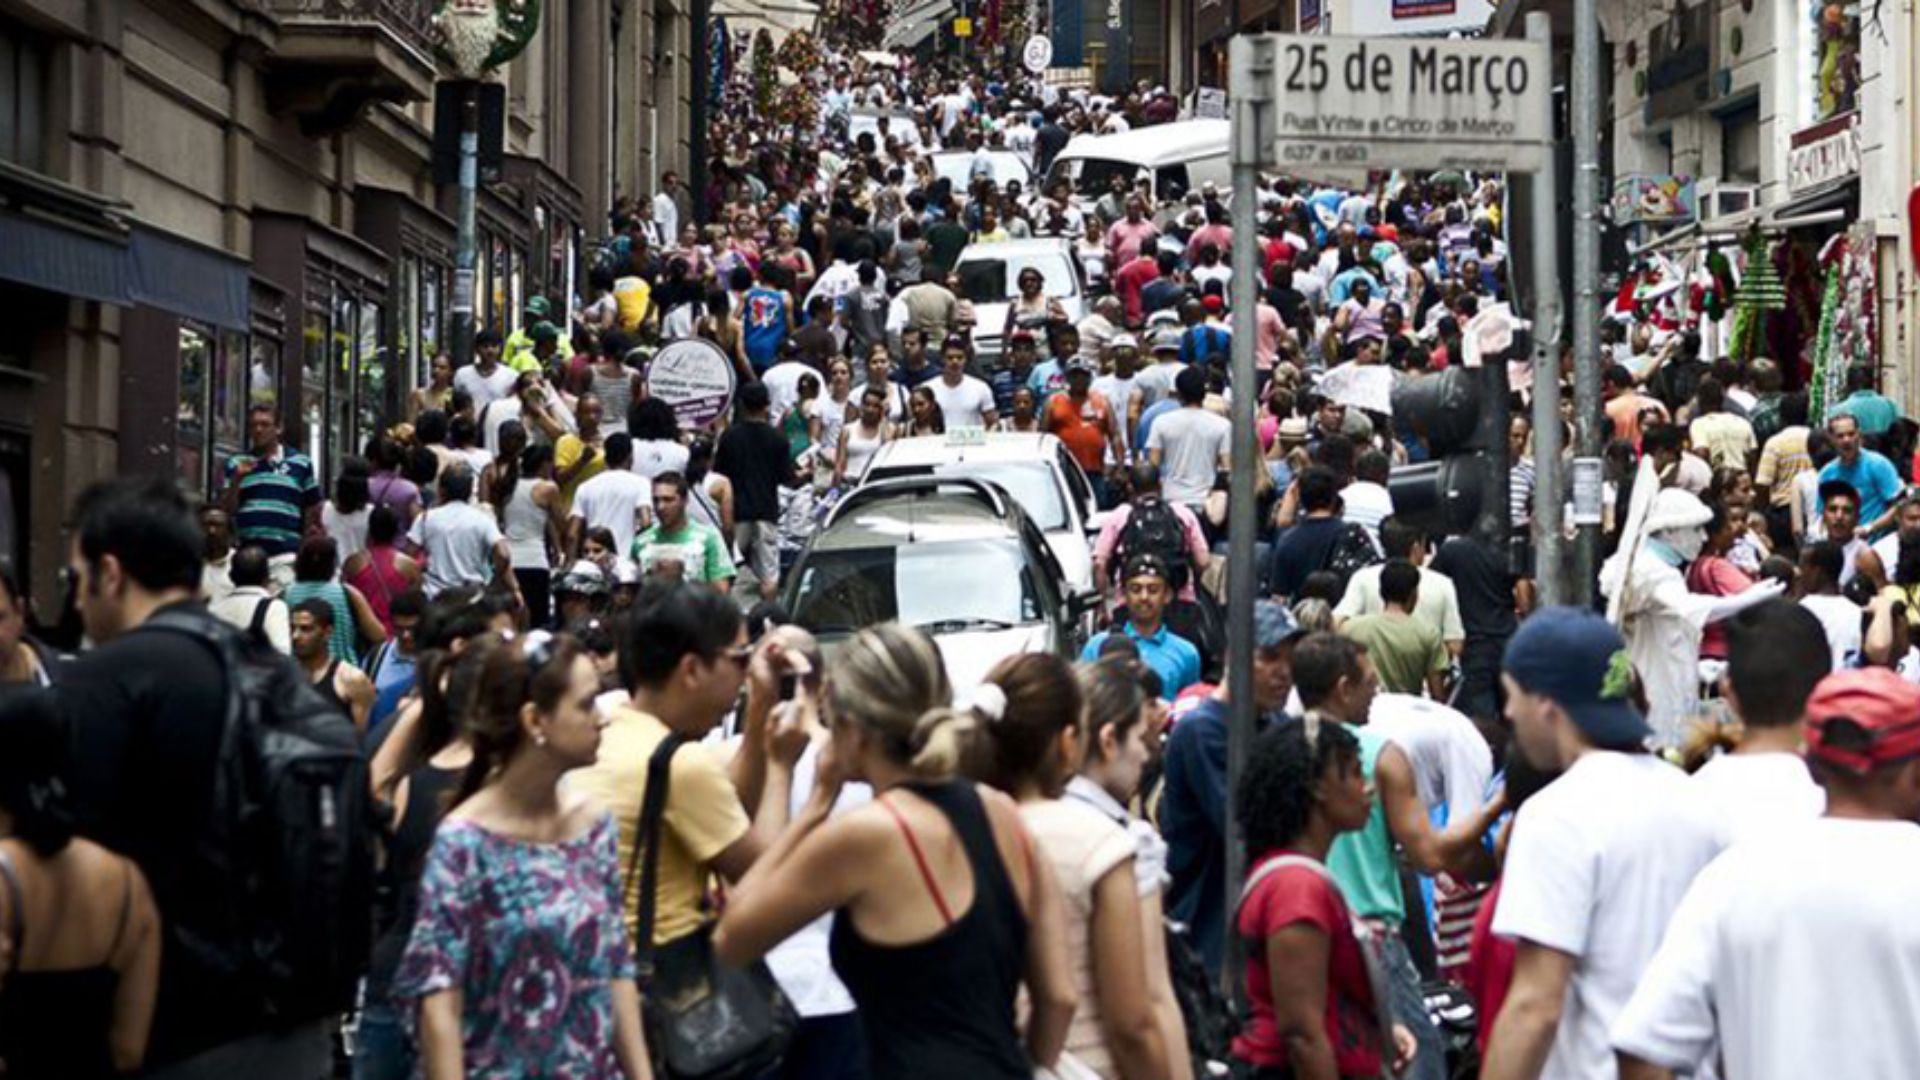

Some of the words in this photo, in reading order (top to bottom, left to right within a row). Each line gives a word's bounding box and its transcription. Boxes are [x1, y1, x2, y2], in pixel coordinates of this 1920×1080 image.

[1285, 44, 1328, 92] 25
[1344, 42, 1392, 93] de
[1409, 46, 1528, 109] Março
[1283, 114, 1317, 131] Rua
[1321, 114, 1364, 132] Vinte
[1369, 120, 1379, 133] e
[1384, 115, 1432, 132] Cinco
[1436, 117, 1457, 133] de
[1462, 117, 1515, 135] Março
